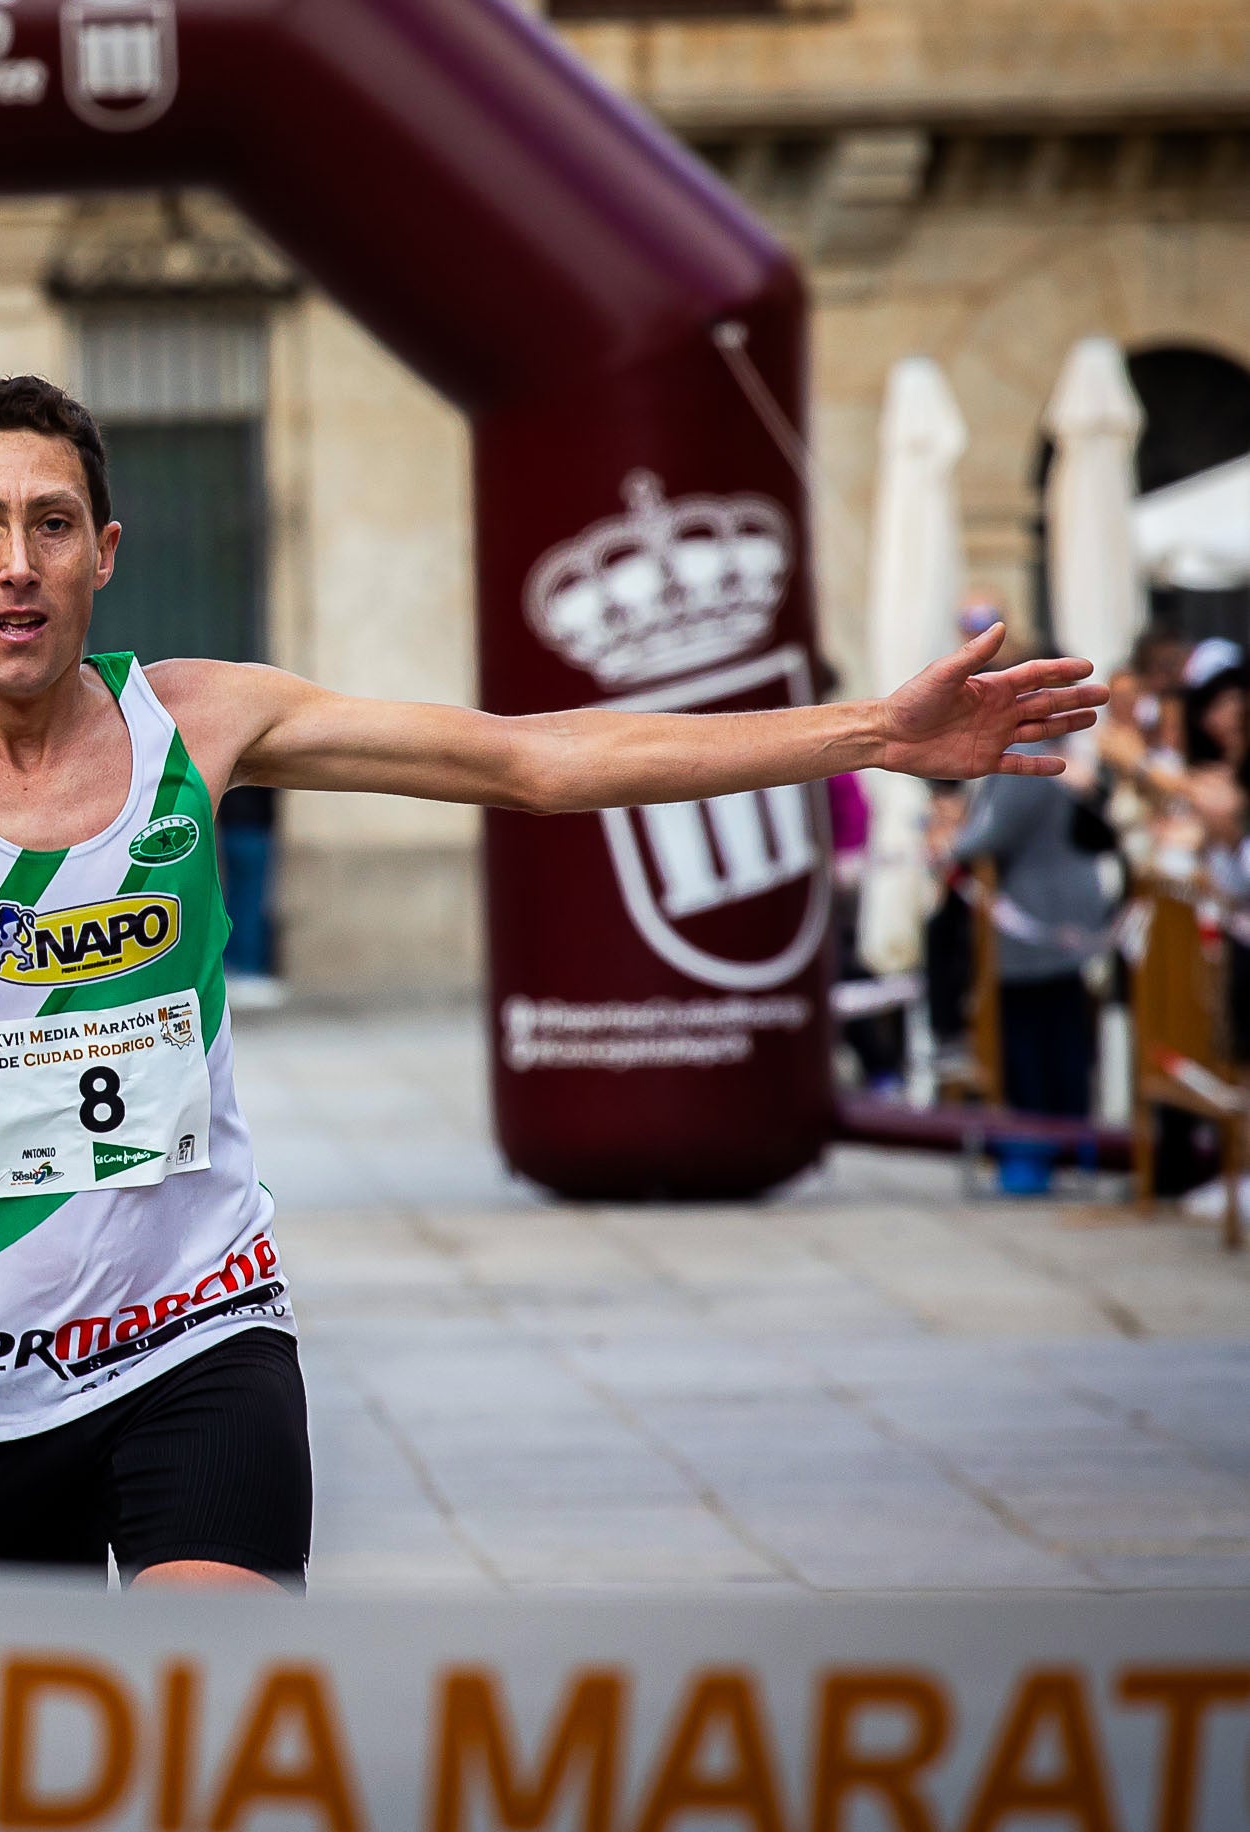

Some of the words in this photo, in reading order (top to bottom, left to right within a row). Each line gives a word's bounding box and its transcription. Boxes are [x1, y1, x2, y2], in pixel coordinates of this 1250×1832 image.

[35, 904, 170, 968] NAPO
[79, 1065, 125, 1133] 8
[21, 1147, 56, 1159] ANTONIO
